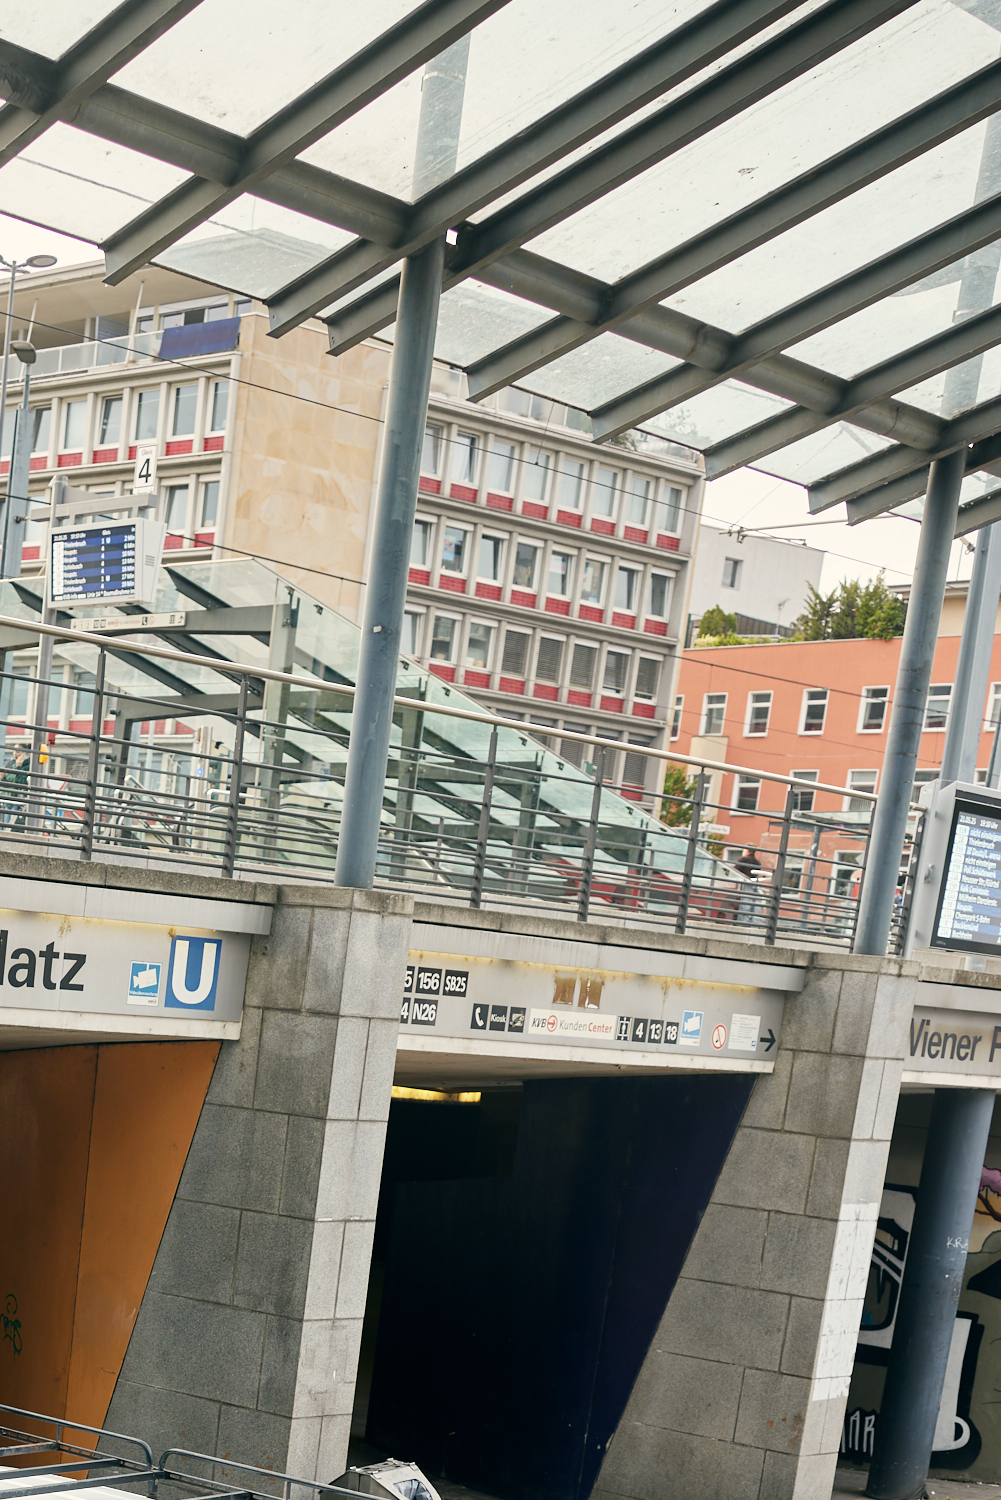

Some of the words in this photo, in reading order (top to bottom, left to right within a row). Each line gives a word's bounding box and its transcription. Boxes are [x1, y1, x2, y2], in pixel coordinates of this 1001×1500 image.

[138, 458, 151, 483] 4
[172, 939, 217, 1005] U
[418, 972, 440, 991] 156
[444, 975, 466, 993] SB25
[412, 1003, 437, 1022] N26
[490, 1013, 506, 1023] Kiosk
[532, 1017, 547, 1028] KVB
[635, 1022, 644, 1039] 4
[650, 1023, 661, 1040] 13
[666, 1025, 677, 1041] 18
